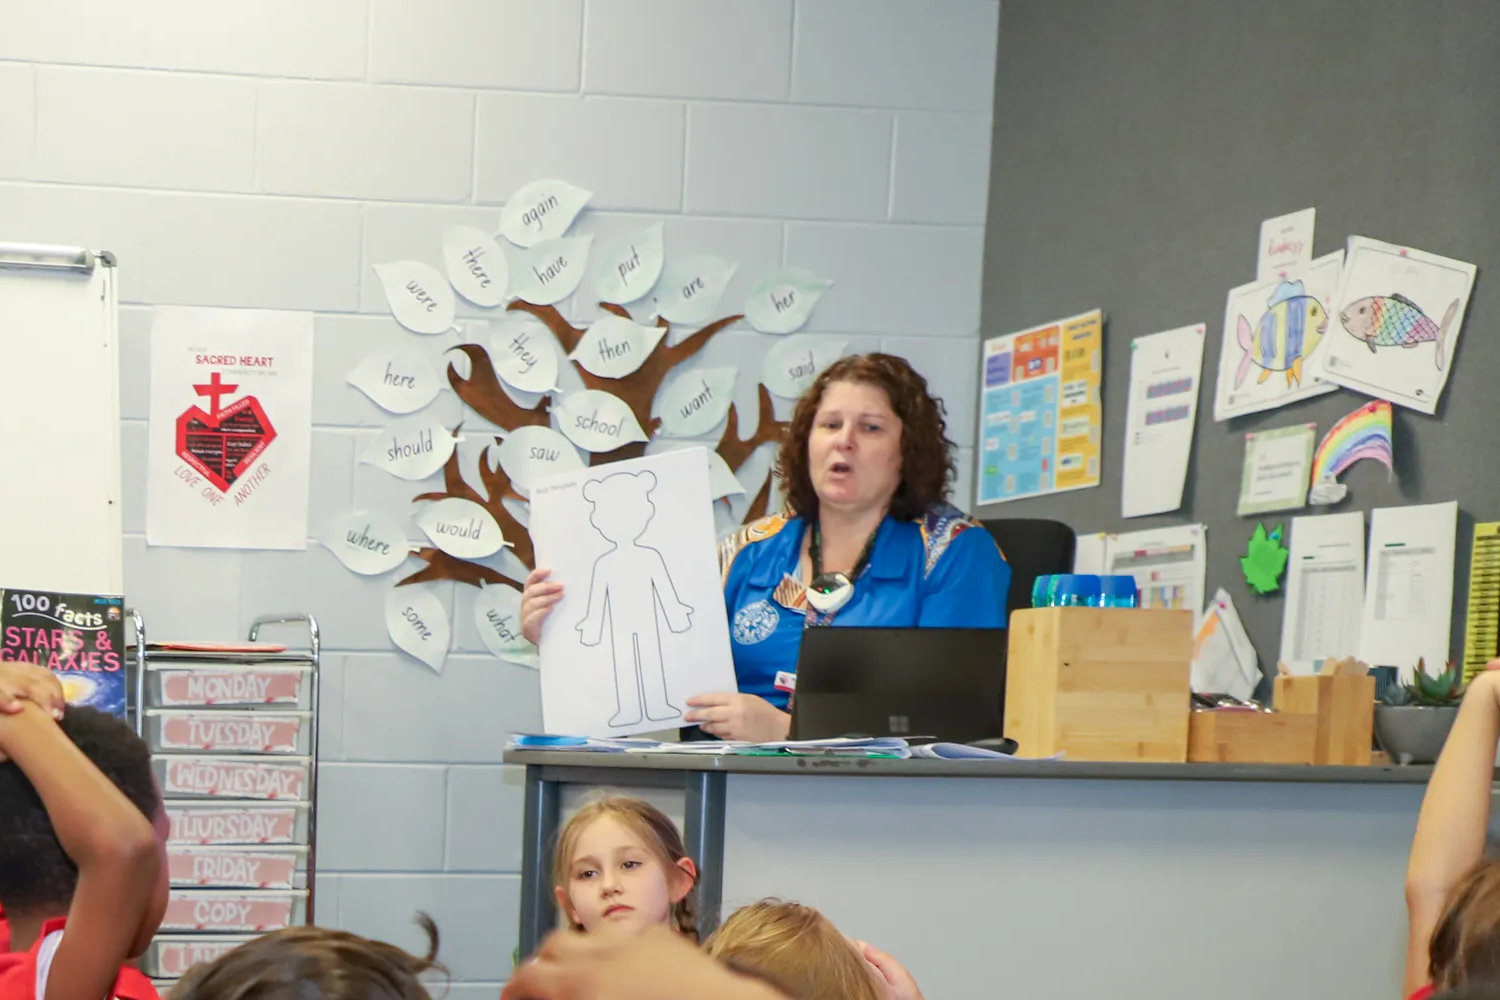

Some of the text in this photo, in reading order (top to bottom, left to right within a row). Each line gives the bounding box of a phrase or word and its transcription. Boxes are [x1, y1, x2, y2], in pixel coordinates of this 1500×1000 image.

[521, 194, 559, 230] again
[461, 246, 492, 290] there
[532, 255, 568, 285] have
[617, 244, 642, 283] put
[405, 279, 438, 313] were
[681, 275, 705, 300] are
[770, 288, 797, 315] her
[195, 354, 274, 368] SACRED HEART
[509, 332, 538, 374] they
[598, 337, 632, 363] then
[383, 365, 416, 391] here
[788, 355, 816, 381] said
[679, 381, 714, 420] want
[574, 411, 625, 439] school
[387, 434, 434, 462] should
[528, 444, 561, 463] saw
[173, 462, 272, 508] LOVE ONE ANOTHER
[345, 525, 391, 557] where
[435, 518, 482, 542] would
[10, 593, 104, 627] 100 facts
[401, 605, 431, 643] some
[5, 625, 113, 651] STARS &
[485, 606, 520, 646] what
[187, 674, 273, 699] MONDAY
[187, 719, 276, 746] TUESDAY
[176, 764, 296, 793] WEDNESDAY
[169, 814, 280, 840] THURSDAY
[192, 856, 261, 880] FRIDAY
[193, 900, 252, 924] COPY
